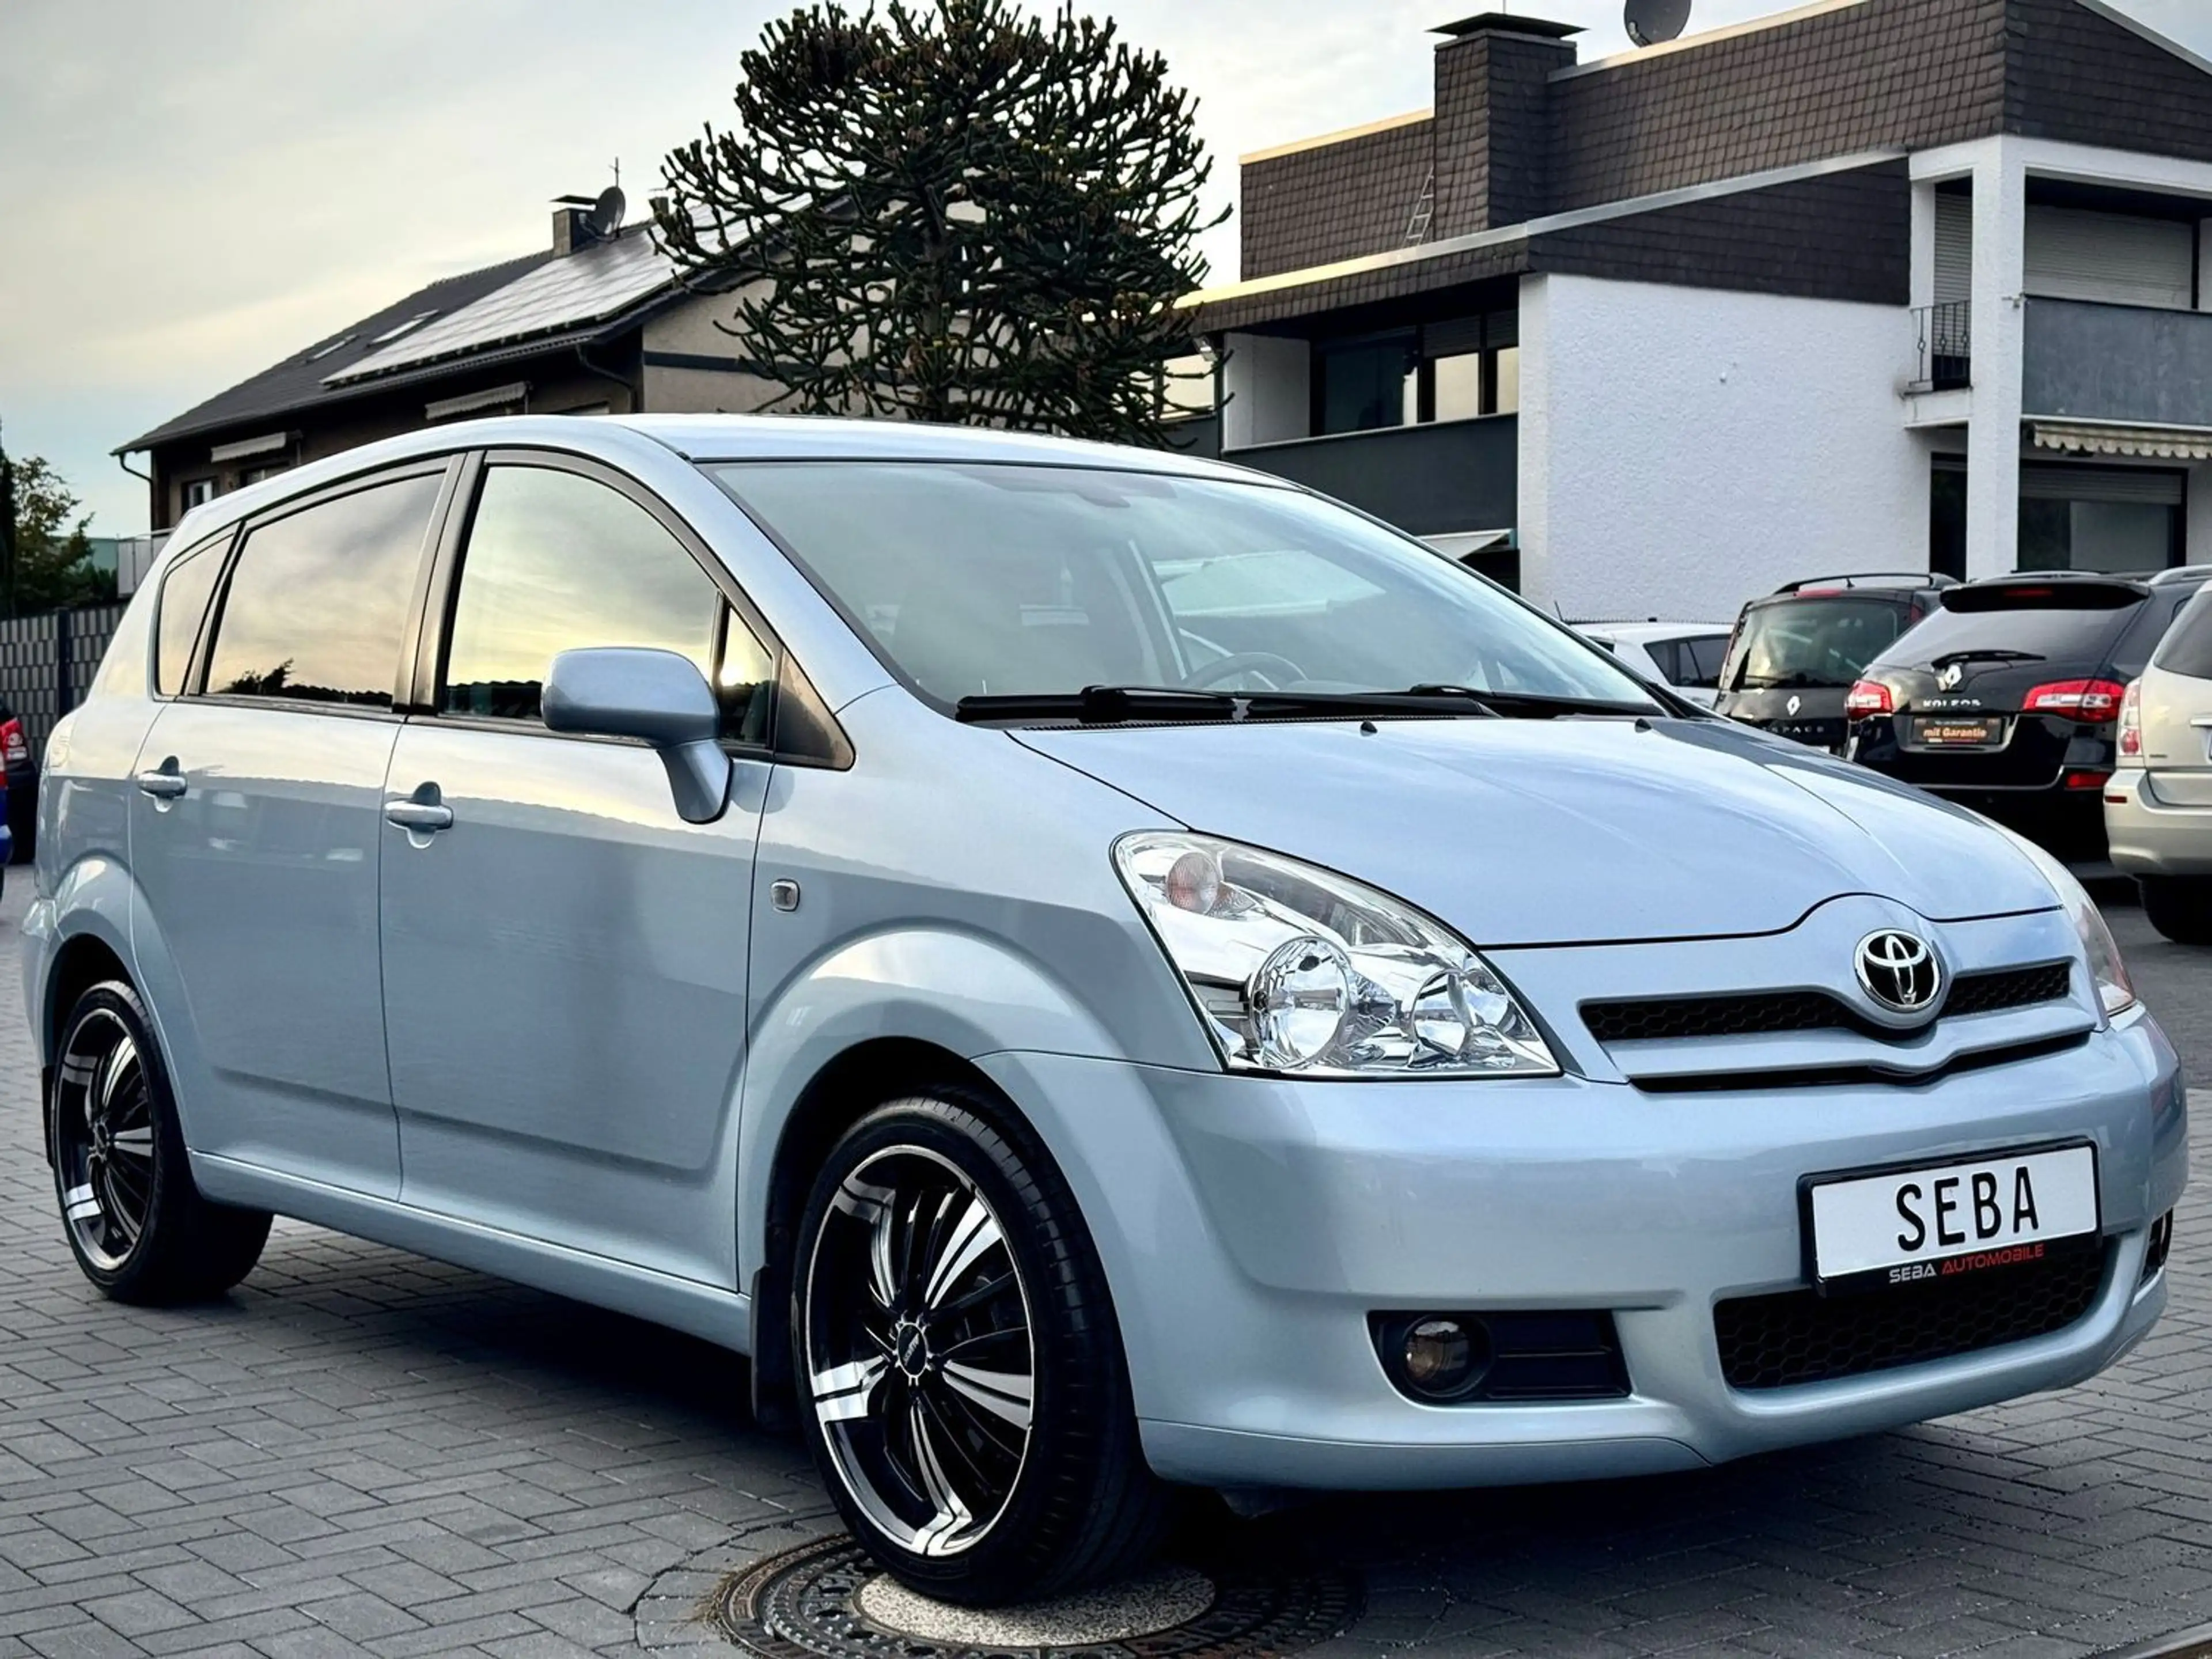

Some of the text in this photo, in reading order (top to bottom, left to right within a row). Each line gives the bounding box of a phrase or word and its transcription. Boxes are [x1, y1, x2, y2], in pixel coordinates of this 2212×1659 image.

[1923, 726, 1987, 738] mit Garantie
[1896, 1166, 2038, 1251] SEBA
[1889, 1244, 2045, 1283] SEBA AUTOMOBILE
